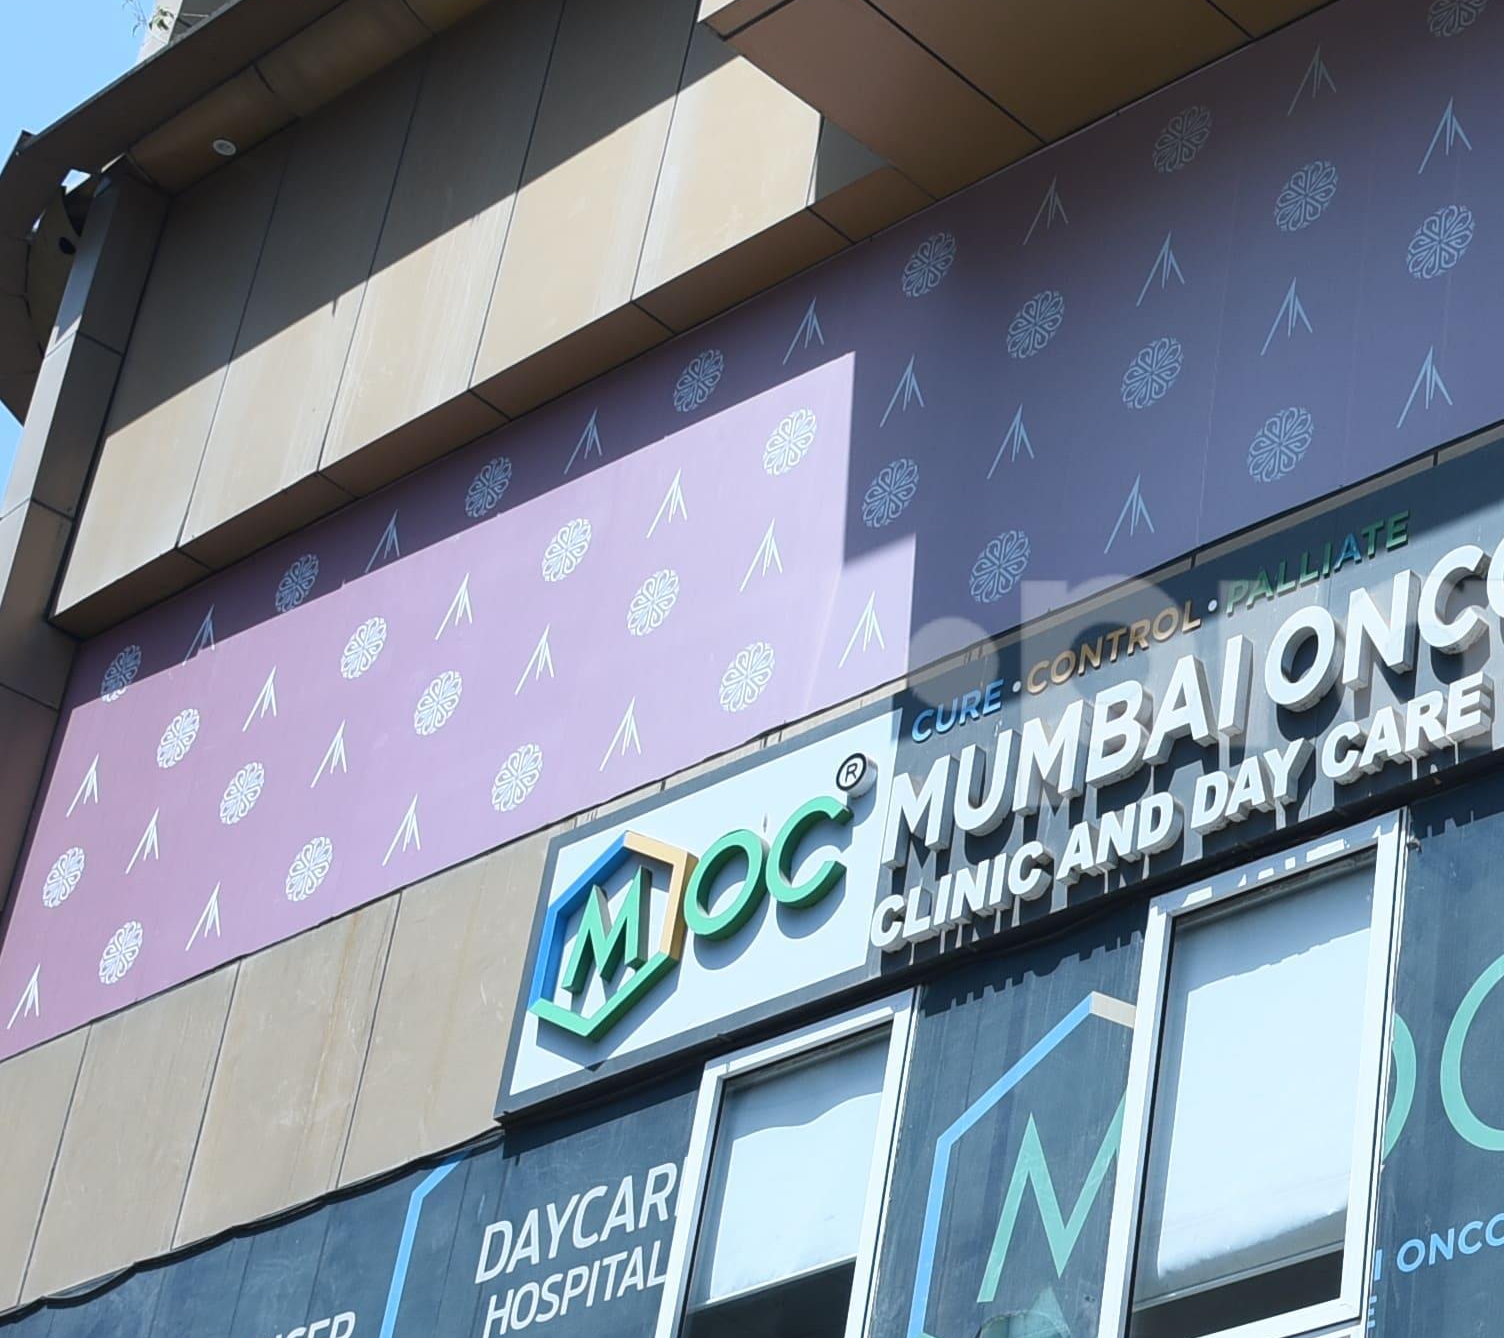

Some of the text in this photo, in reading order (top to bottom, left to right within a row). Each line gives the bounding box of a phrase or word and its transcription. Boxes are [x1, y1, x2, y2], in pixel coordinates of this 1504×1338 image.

[912, 511, 1410, 744] CURE CONTROL PALLIATE
[870, 841, 1055, 952] CLINIC
[1055, 792, 1187, 883] AND
[1191, 741, 1308, 836] DAY
[1321, 673, 1493, 785] CARE
[882, 635, 1255, 868] MUMBAI
